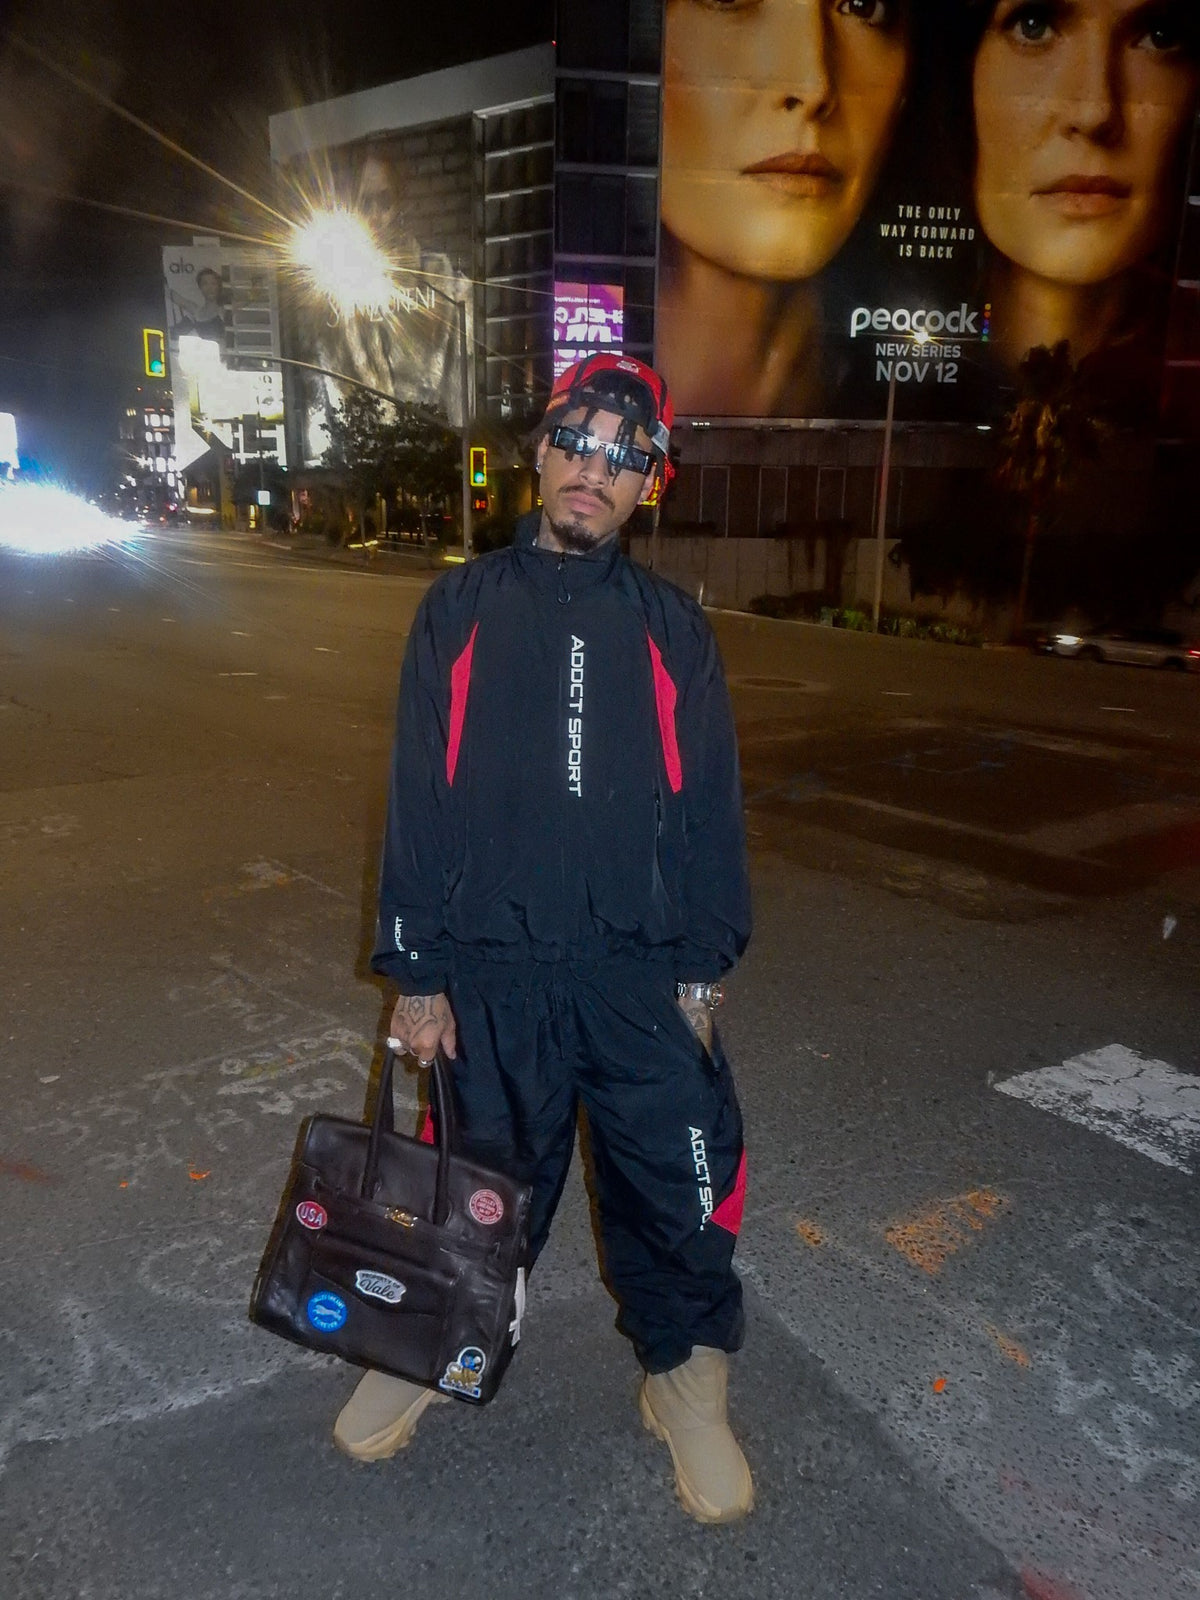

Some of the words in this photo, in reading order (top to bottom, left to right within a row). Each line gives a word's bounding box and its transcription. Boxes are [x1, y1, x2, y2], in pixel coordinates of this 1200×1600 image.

[898, 205, 921, 219] THE
[928, 206, 961, 221] ONLY
[880, 223, 907, 238] WAY
[914, 226, 975, 241] FORWARD
[900, 244, 913, 257] IS
[920, 245, 954, 259] BACK
[169, 257, 195, 273] alo
[850, 303, 979, 338] peacock
[875, 343, 908, 357] NEW
[911, 345, 961, 358] SERIES
[875, 360, 930, 383] NOV
[935, 362, 959, 383] 12
[569, 634, 585, 714] ADDCT
[568, 717, 582, 798] SPORT
[688, 1126, 711, 1184] ADDCT
[301, 1204, 324, 1226] USA
[360, 1279, 396, 1299] Vale
